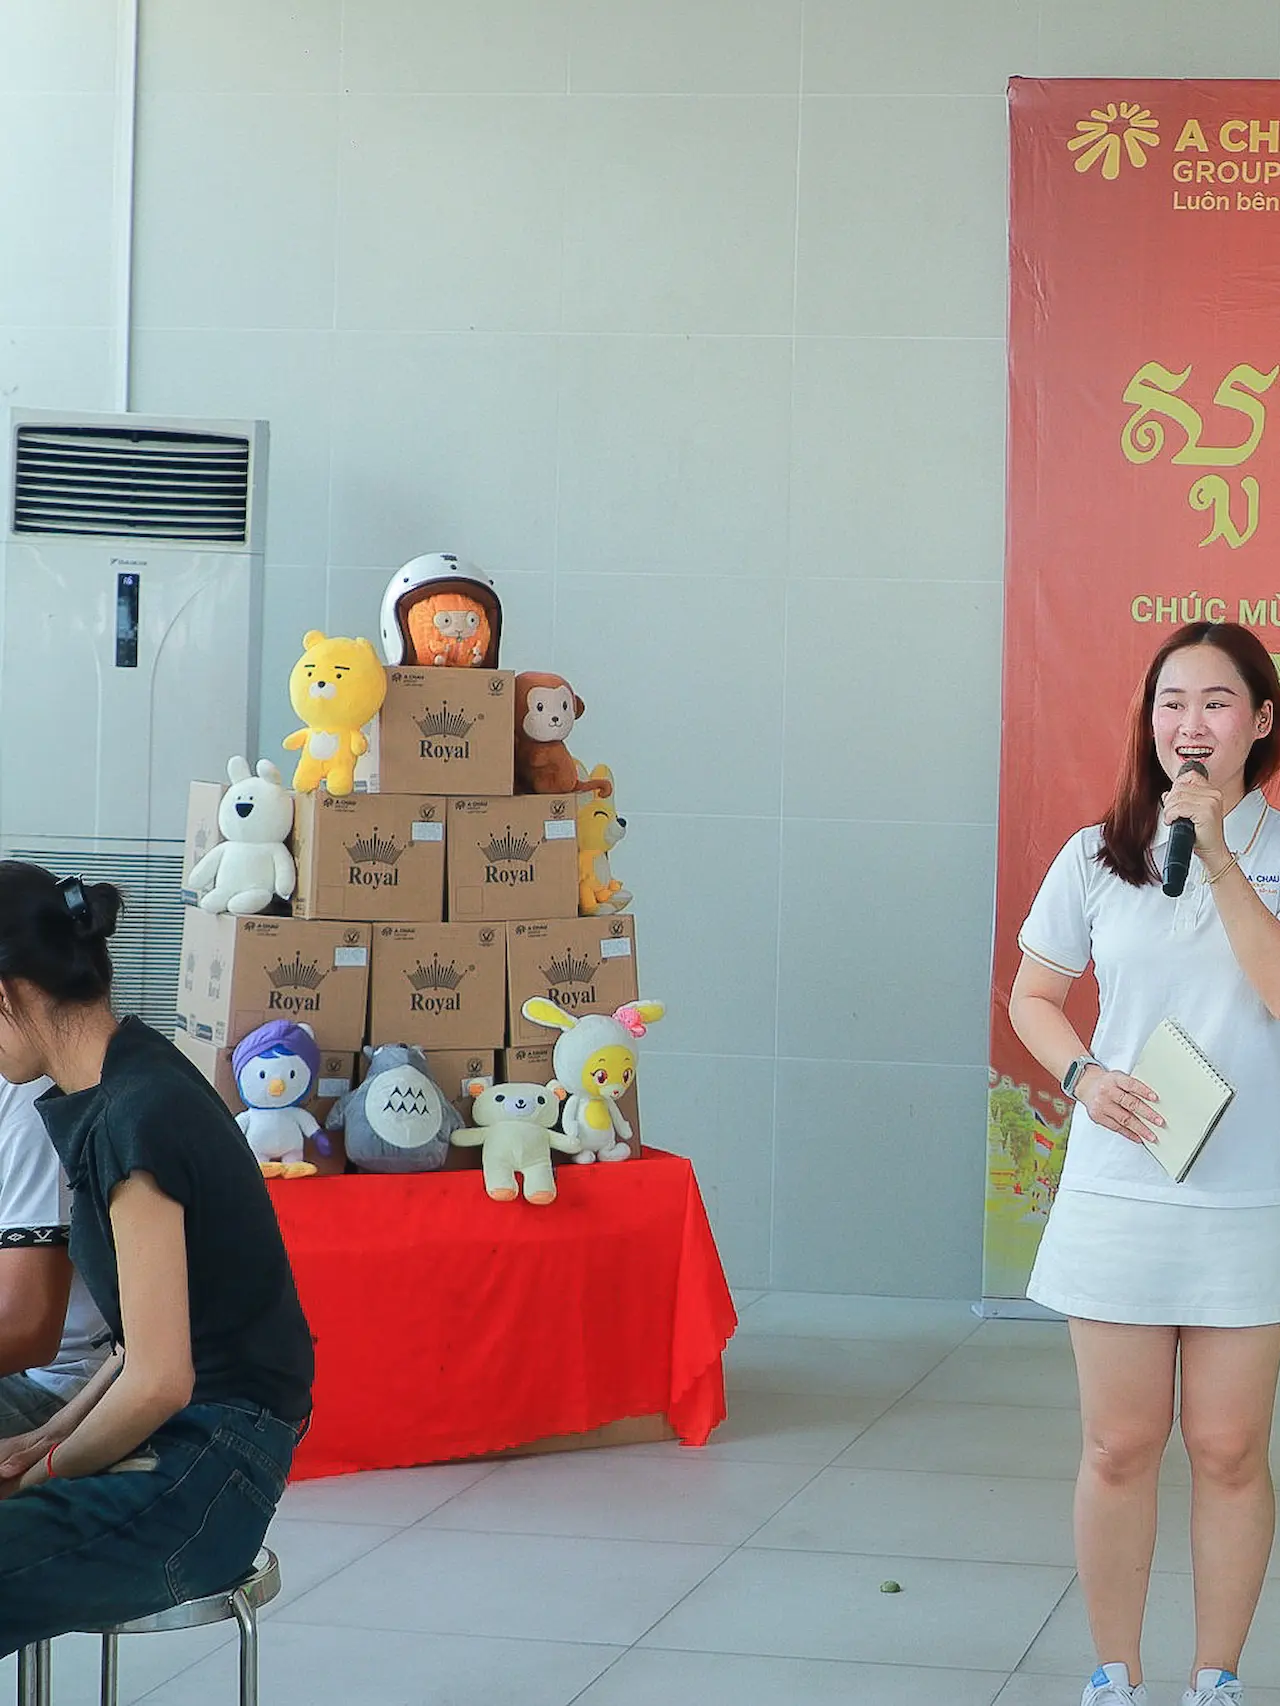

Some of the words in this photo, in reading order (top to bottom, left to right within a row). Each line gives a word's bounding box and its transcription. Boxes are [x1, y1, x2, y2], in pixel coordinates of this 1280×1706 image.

[1174, 119, 1209, 152] A
[1173, 190, 1230, 211] Luôn
[1236, 192, 1279, 212] bên
[1130, 590, 1226, 625] CHÚC
[419, 740, 469, 763] Royal
[349, 866, 399, 889] Royal
[485, 864, 534, 887] Royal
[1256, 874, 1280, 883] CHAU
[268, 990, 320, 1015] Royal
[410, 992, 460, 1015] Royal
[547, 985, 597, 1009] Royal
